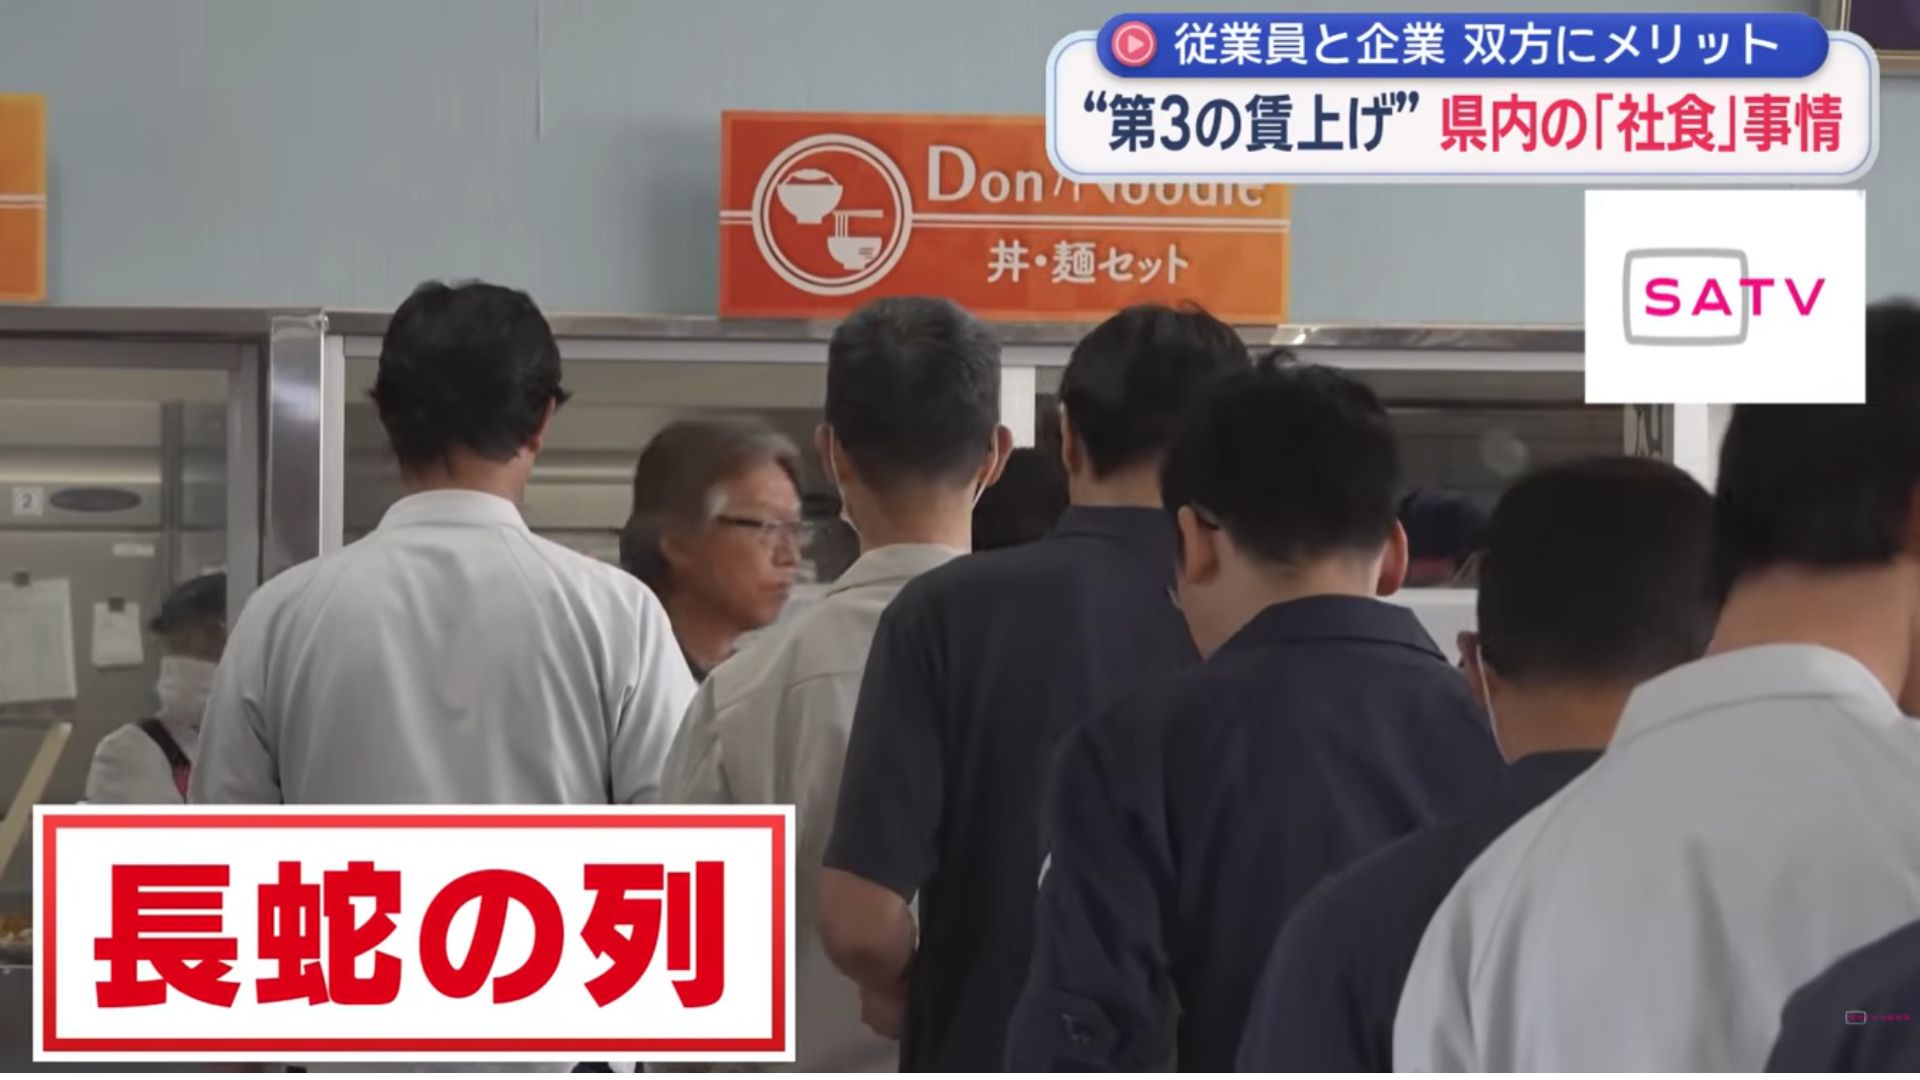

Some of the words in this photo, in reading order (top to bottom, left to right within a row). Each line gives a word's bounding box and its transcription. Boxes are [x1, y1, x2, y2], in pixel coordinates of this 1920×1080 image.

[986, 240, 1189, 284] 丼・麺セット
